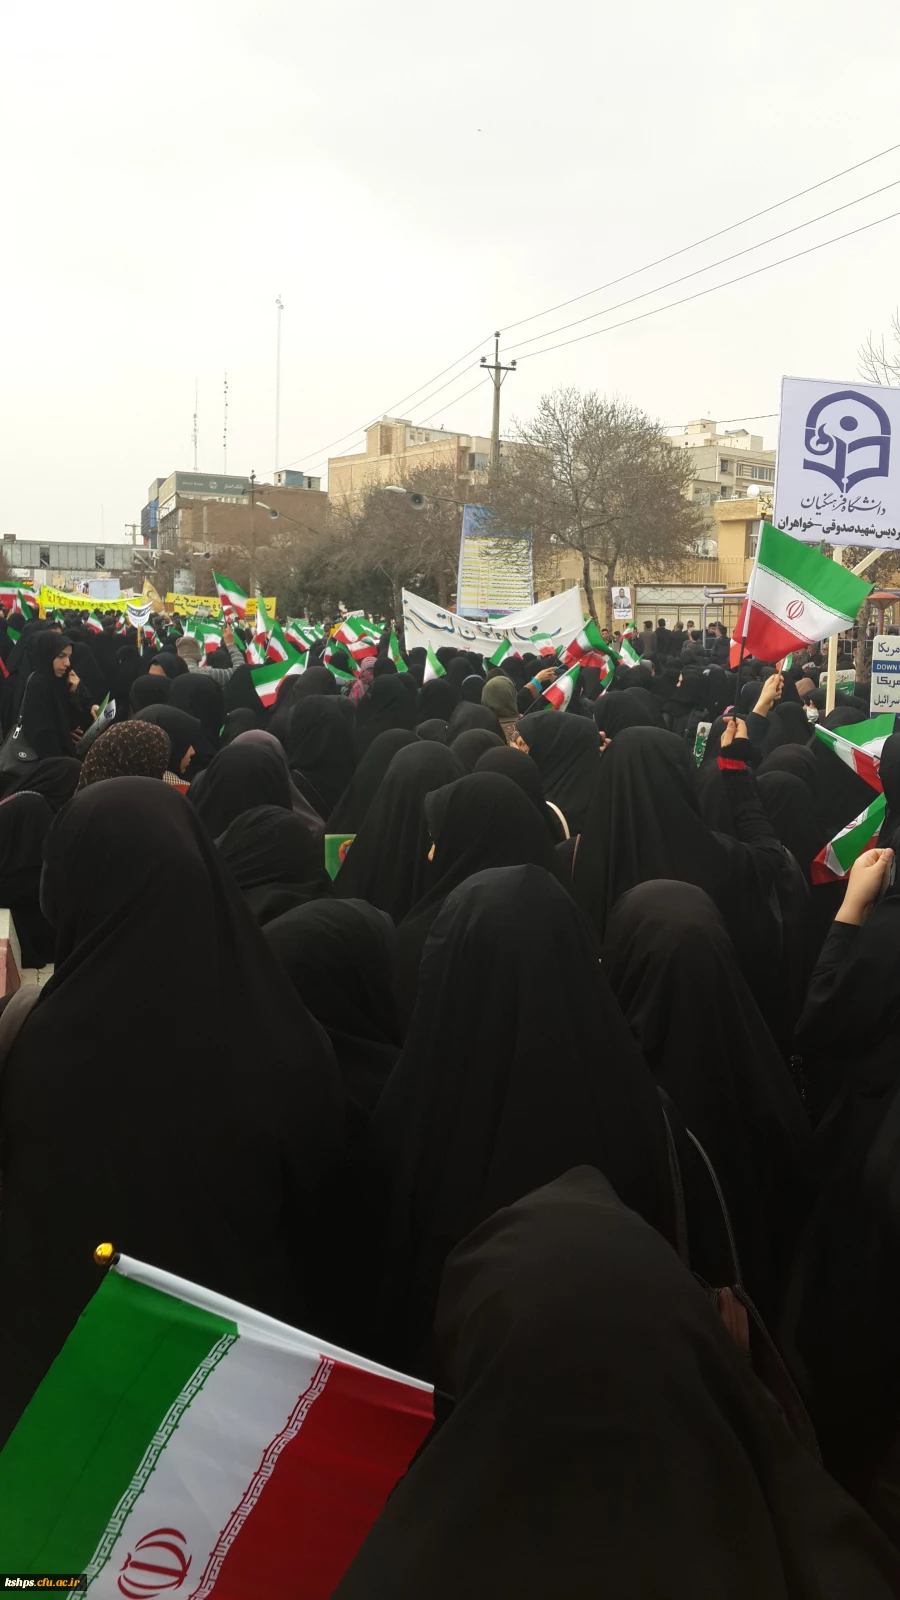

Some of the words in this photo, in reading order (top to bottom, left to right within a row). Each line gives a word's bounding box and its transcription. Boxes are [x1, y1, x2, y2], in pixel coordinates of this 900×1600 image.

[801, 493, 847, 515] فرهنگیان
[841, 496, 886, 515] دانشگاه
[778, 516, 814, 532] خواهران
[822, 519, 855, 535] صدوقی
[854, 523, 876, 537] شهید
[875, 527, 900, 540] ردیس
[878, 641, 900, 657] مریکا
[876, 663, 898, 671] DOWN
[874, 694, 900, 708] سرائیل
